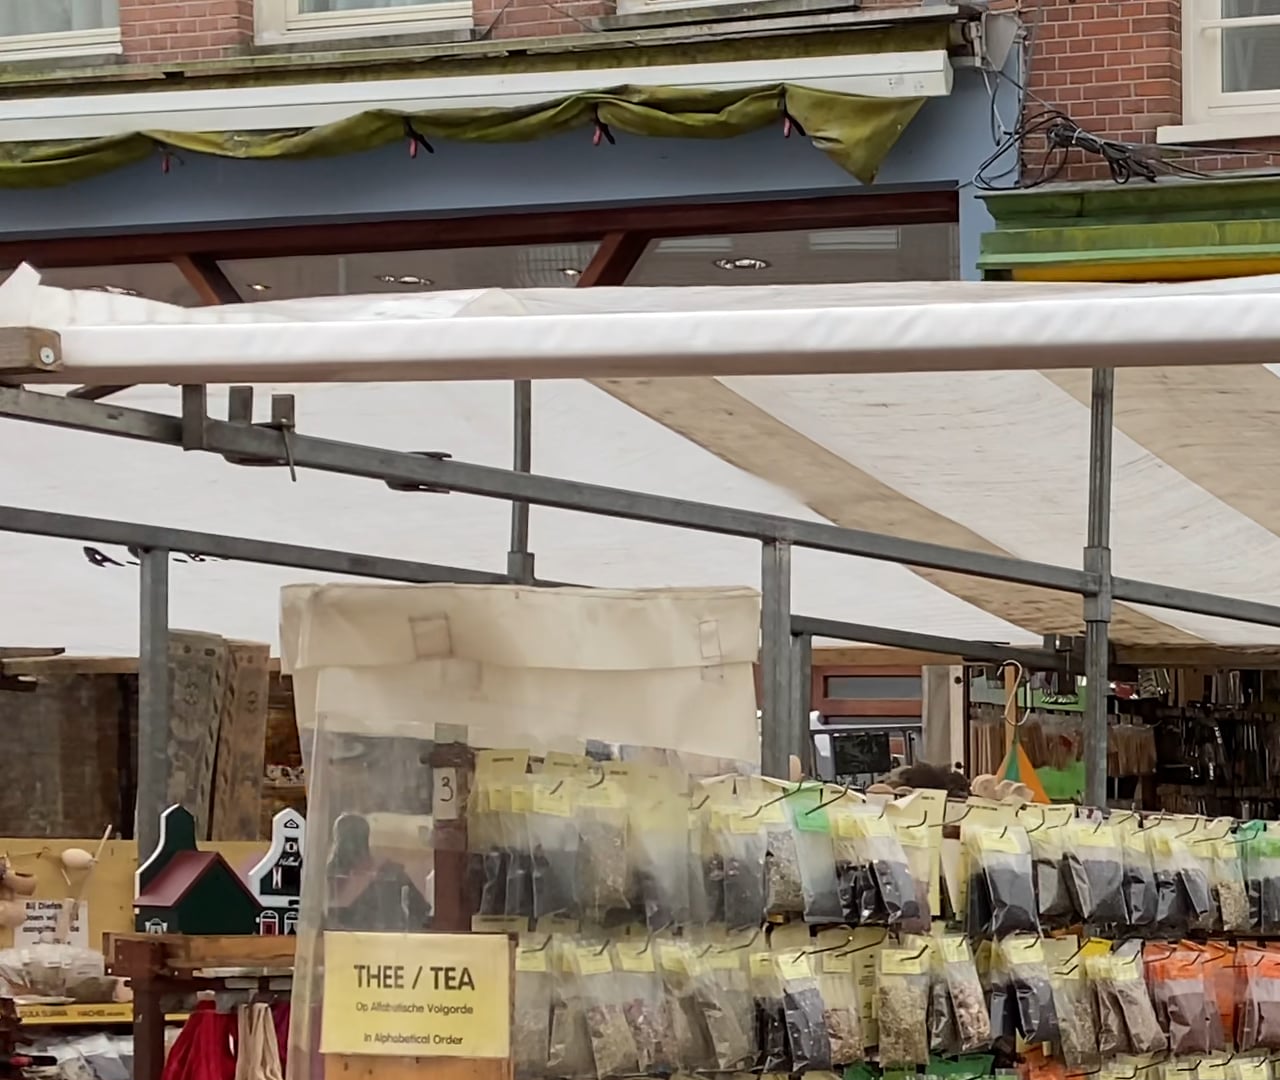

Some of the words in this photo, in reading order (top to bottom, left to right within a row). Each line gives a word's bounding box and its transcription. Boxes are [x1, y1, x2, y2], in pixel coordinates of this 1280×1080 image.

[440, 776, 454, 802] 3
[354, 965, 404, 988] THEE
[430, 967, 475, 990] TEA
[356, 1002, 369, 1013] Op
[427, 1003, 474, 1016] Volgorde
[364, 1033, 372, 1043] In
[374, 1033, 430, 1045] Alphabetical
[433, 1034, 463, 1045] Order
